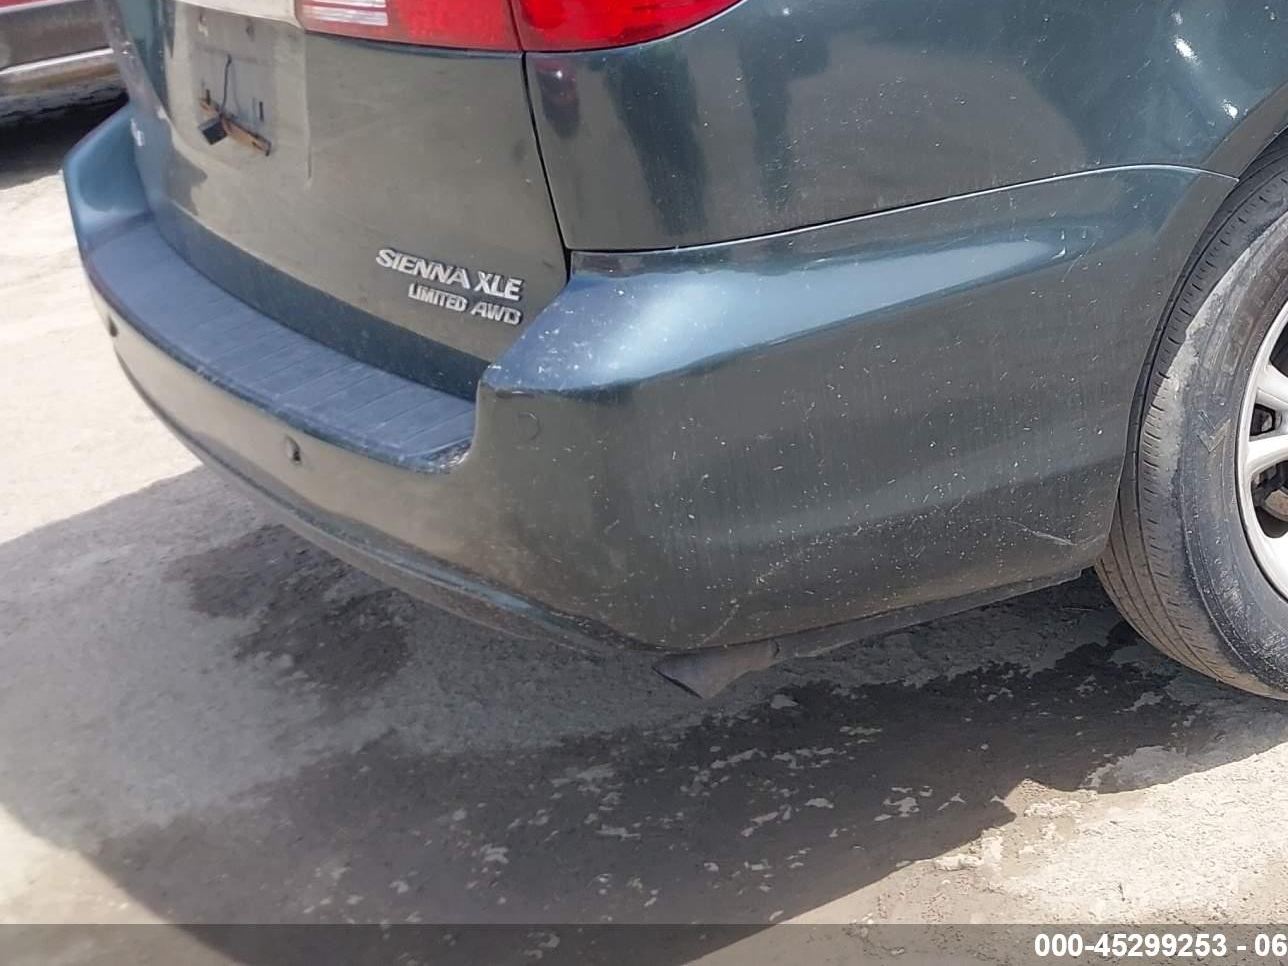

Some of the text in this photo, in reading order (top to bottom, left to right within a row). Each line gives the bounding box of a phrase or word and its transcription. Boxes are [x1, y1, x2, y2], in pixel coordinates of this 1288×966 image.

[375, 248, 523, 301] SIENNA XLE
[408, 283, 522, 325] LIMITED AWD
